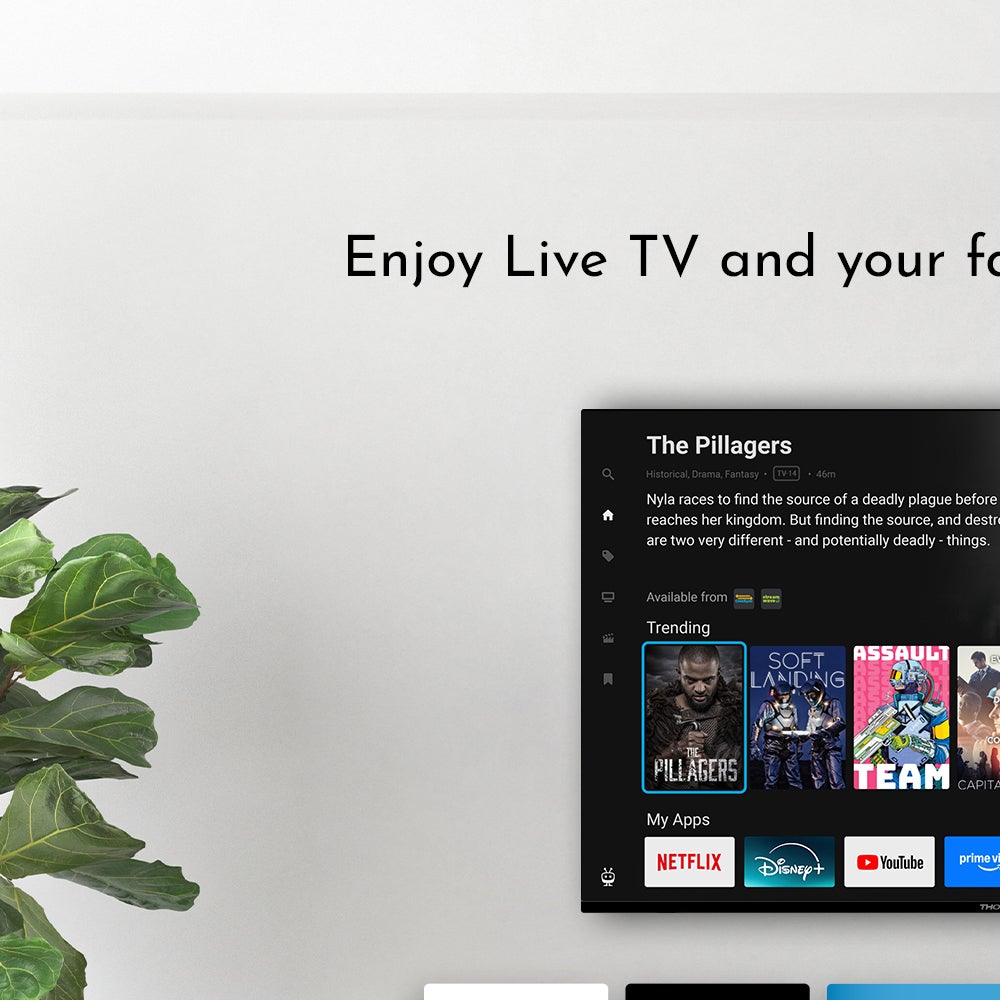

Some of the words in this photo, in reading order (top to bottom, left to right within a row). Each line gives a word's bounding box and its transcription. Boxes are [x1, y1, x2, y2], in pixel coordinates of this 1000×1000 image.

[647, 435, 688, 454] The
[696, 435, 792, 459] Pillagers
[646, 469, 690, 480] Historical,
[691, 469, 723, 480] Drama,
[724, 469, 760, 480] Fantasy
[815, 470, 836, 479] 46m
[647, 494, 674, 508] Nyla
[679, 496, 713, 505] races
[718, 494, 730, 505] to
[734, 493, 758, 505] find
[762, 493, 782, 505] the
[787, 496, 830, 505] source
[834, 493, 847, 505] of
[851, 496, 858, 505] a
[863, 493, 904, 508] deadly
[909, 493, 952, 508] plague
[956, 493, 997, 505] before
[647, 514, 697, 526] reaches
[702, 514, 722, 526] her
[726, 514, 785, 528] kingdom.
[790, 514, 811, 526] But
[815, 513, 858, 528] finding
[863, 514, 883, 526] the
[887, 516, 933, 528] source,
[938, 514, 960, 526] and
[647, 537, 666, 546] are
[671, 535, 694, 546] two
[698, 537, 725, 549] very
[729, 534, 783, 546] different
[795, 534, 818, 546] and
[823, 534, 889, 549] potentially
[893, 534, 935, 549] deadly
[947, 534, 990, 549] things.
[647, 591, 697, 603] Available
[701, 591, 728, 603] from
[647, 621, 710, 637] Trending
[768, 652, 825, 669] SOFT
[854, 646, 949, 660] ASSAULT
[686, 747, 700, 757] THE
[654, 759, 738, 782] PILLAGERS
[854, 763, 949, 789] TEAM
[648, 813, 668, 830] My
[673, 813, 710, 830] Apps
[657, 853, 721, 871] NETFLIX
[880, 855, 924, 870] YouTube
[960, 853, 990, 865] prime
[754, 856, 824, 881] Disney+
